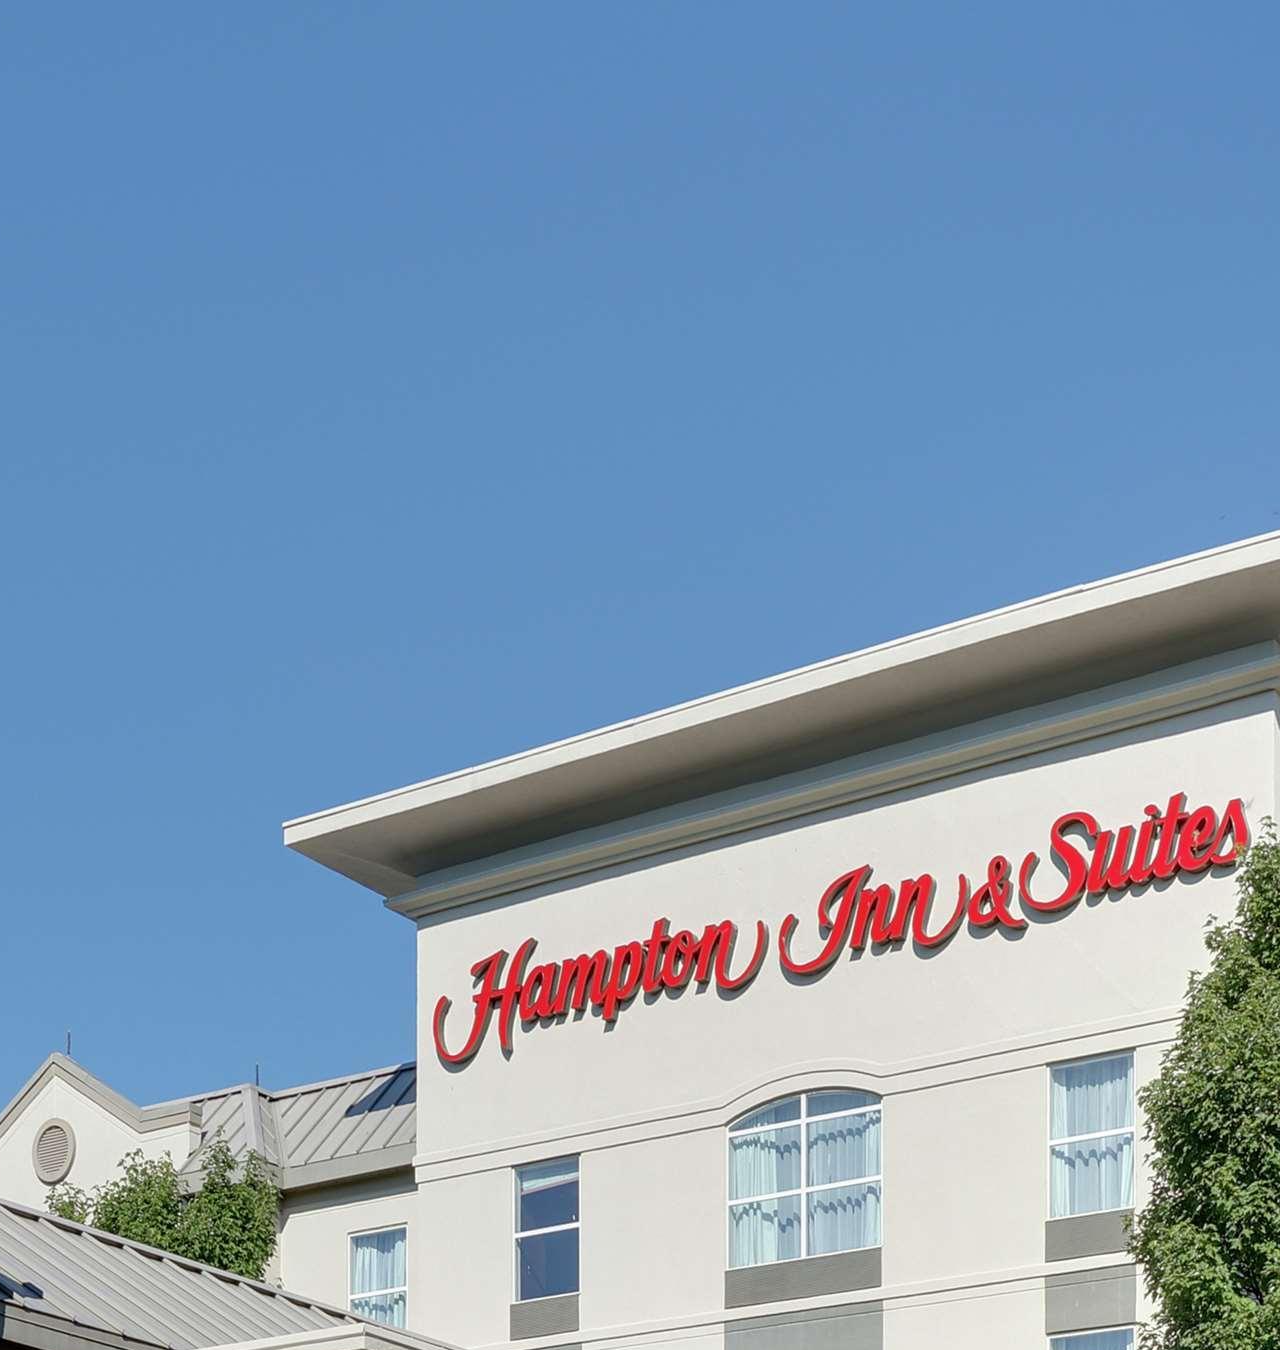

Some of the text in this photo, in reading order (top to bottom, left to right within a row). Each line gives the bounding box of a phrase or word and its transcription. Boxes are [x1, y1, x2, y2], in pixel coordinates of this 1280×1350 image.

[432, 792, 1252, 1064] Hampton Inn & Suites
